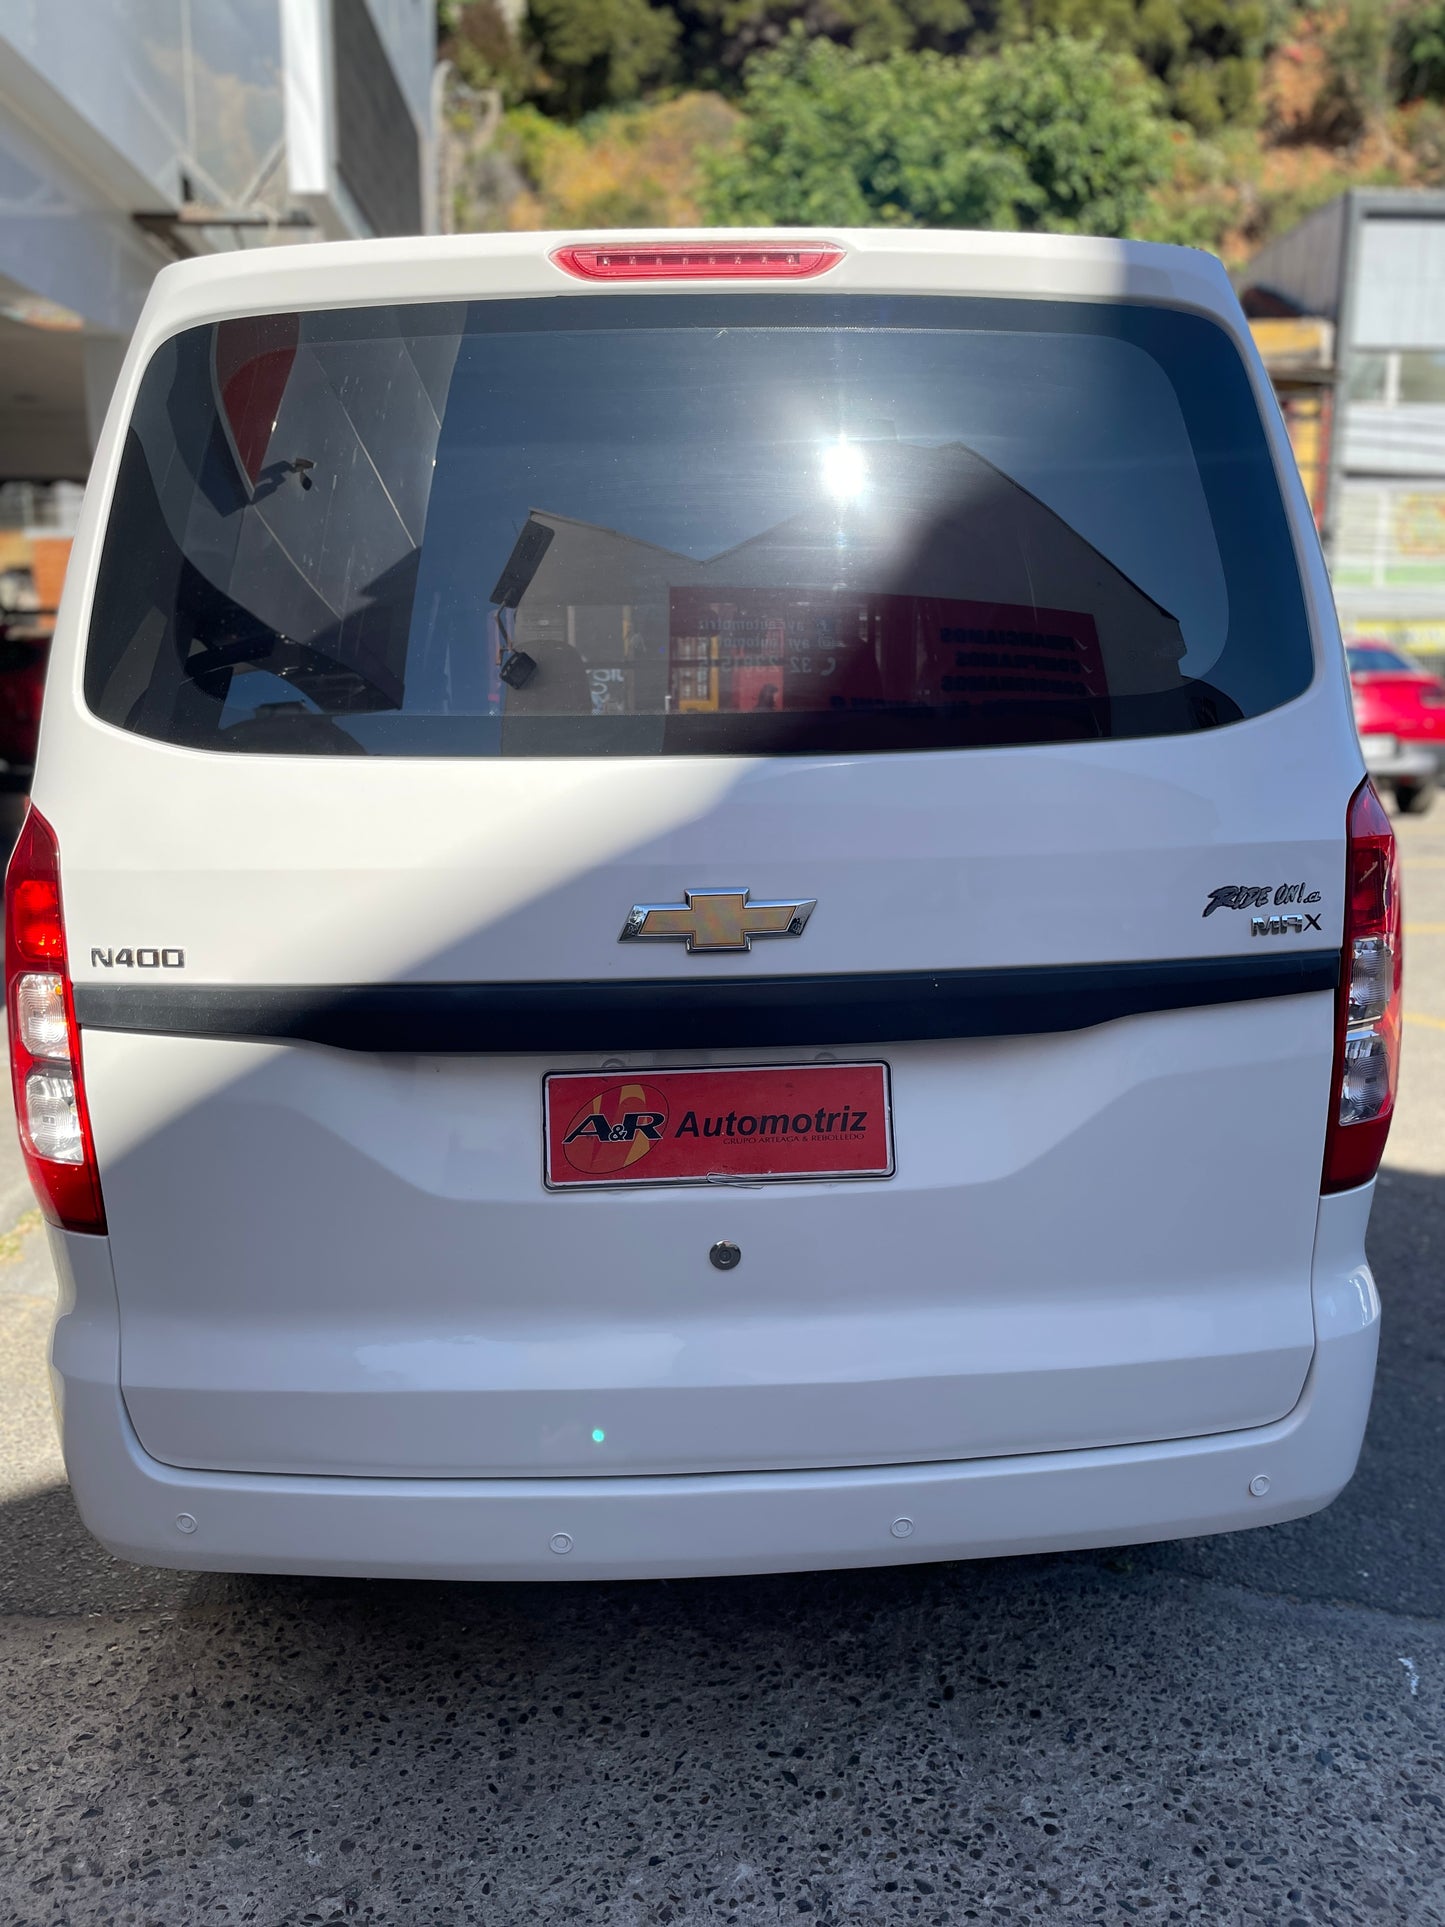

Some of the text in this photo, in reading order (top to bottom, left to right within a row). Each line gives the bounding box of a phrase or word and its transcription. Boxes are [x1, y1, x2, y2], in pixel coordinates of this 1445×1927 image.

[1202, 885, 1273, 918] RIDE
[1250, 913, 1322, 937] MAX
[91, 947, 185, 968] N400
[561, 1106, 869, 1145] A&R Automotriz
[723, 1137, 757, 1145] GRUPO
[758, 1135, 800, 1144] ARTEAGA
[811, 1133, 865, 1142] REBOLLEDO
